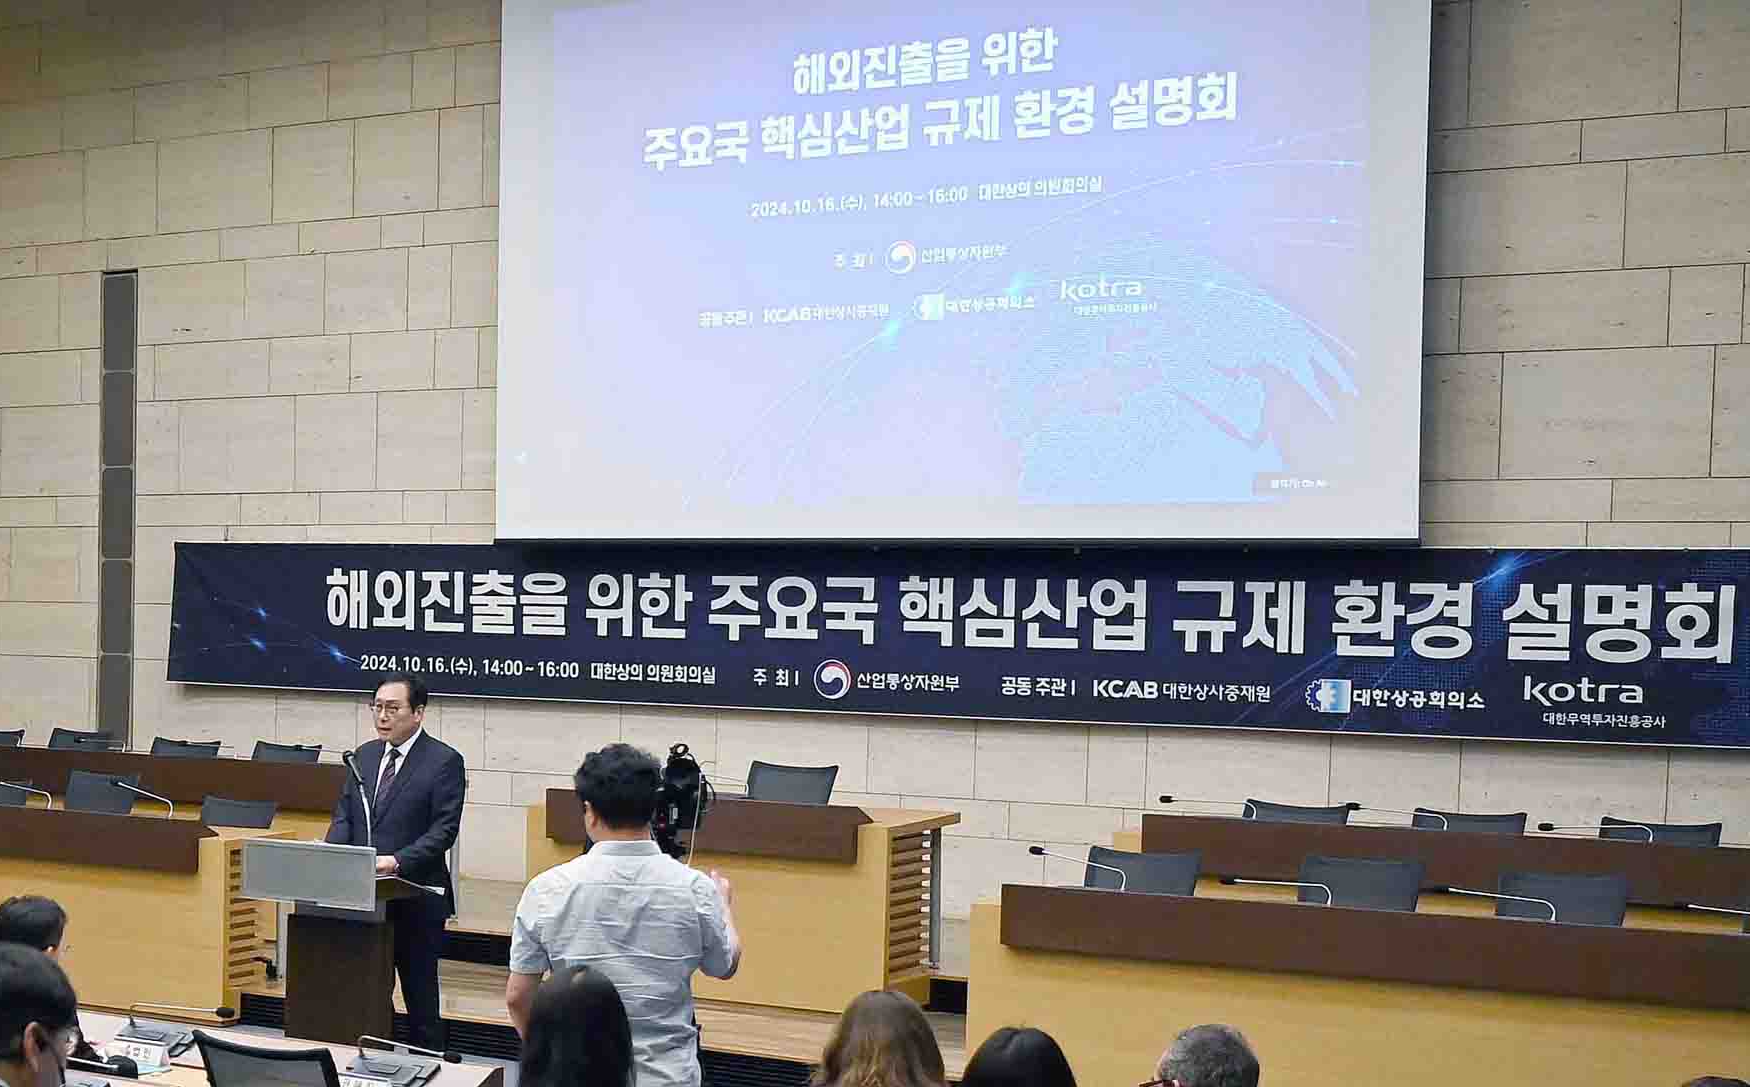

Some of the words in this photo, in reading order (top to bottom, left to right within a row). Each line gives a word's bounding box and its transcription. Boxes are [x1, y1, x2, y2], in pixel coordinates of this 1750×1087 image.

[793, 38, 971, 95] 해외진출을
[980, 26, 1058, 77] 위한
[643, 120, 750, 172] 주요국
[760, 104, 910, 160] 핵심산업
[922, 95, 1001, 146] 규제
[1013, 84, 1095, 138] 환경
[1109, 71, 1238, 130] 설명회
[1060, 276, 1143, 302] kotra
[325, 567, 569, 636] 해외진출을
[585, 571, 694, 640] 위한
[707, 575, 879, 646] 주요국
[898, 575, 1147, 652] 핵심산업
[1172, 580, 1307, 655] 규제
[1330, 580, 1474, 660] 환경
[1501, 582, 1738, 665] 설명회
[360, 655, 478, 676] 2024.10.16.(수),
[590, 662, 644, 682] 대한상의
[646, 664, 717, 685] 의원회의실
[856, 672, 961, 692] 산업통상자원부
[1093, 679, 1159, 699] KCAB
[1161, 682, 1271, 703] 대한상사중재원
[1352, 688, 1486, 710] 대한상공회의소
[1522, 675, 1644, 707] kotra
[1542, 711, 1668, 729] 대한무역투자진흥공사
